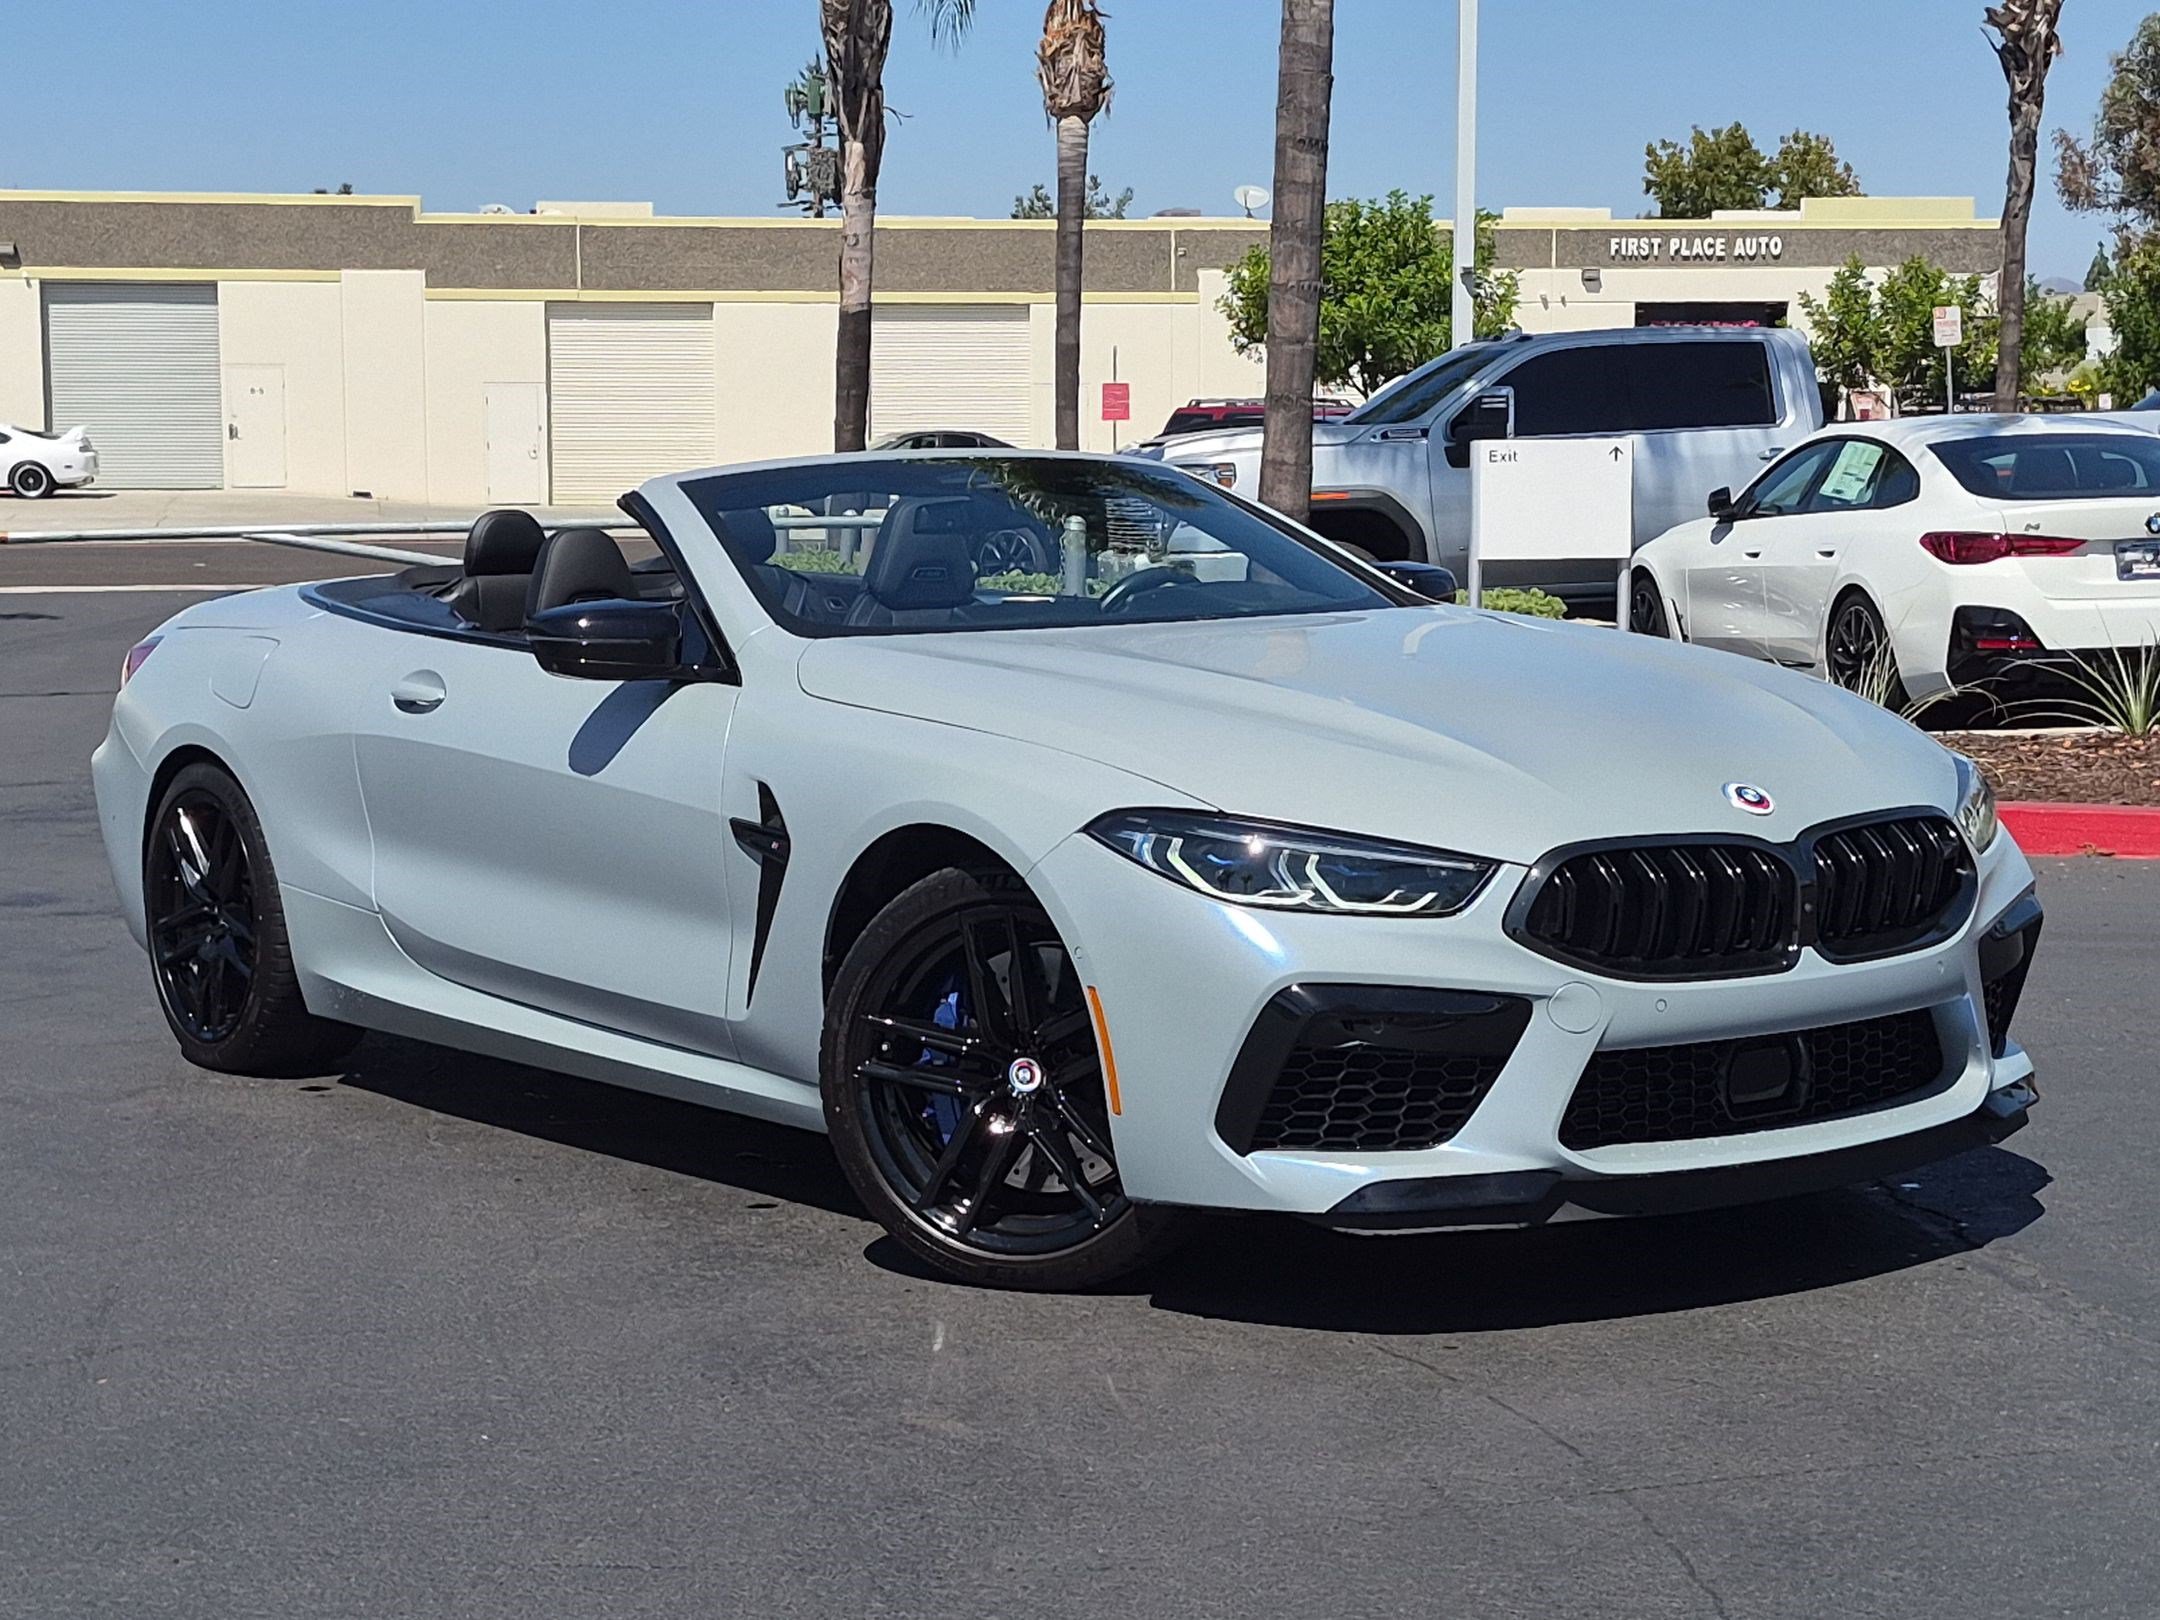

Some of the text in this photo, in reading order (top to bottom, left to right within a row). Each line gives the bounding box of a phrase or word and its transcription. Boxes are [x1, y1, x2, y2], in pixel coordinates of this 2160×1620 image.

[1609, 236, 1783, 257] FIRST PLACE AUTO
[1488, 449, 1519, 463] Exit
